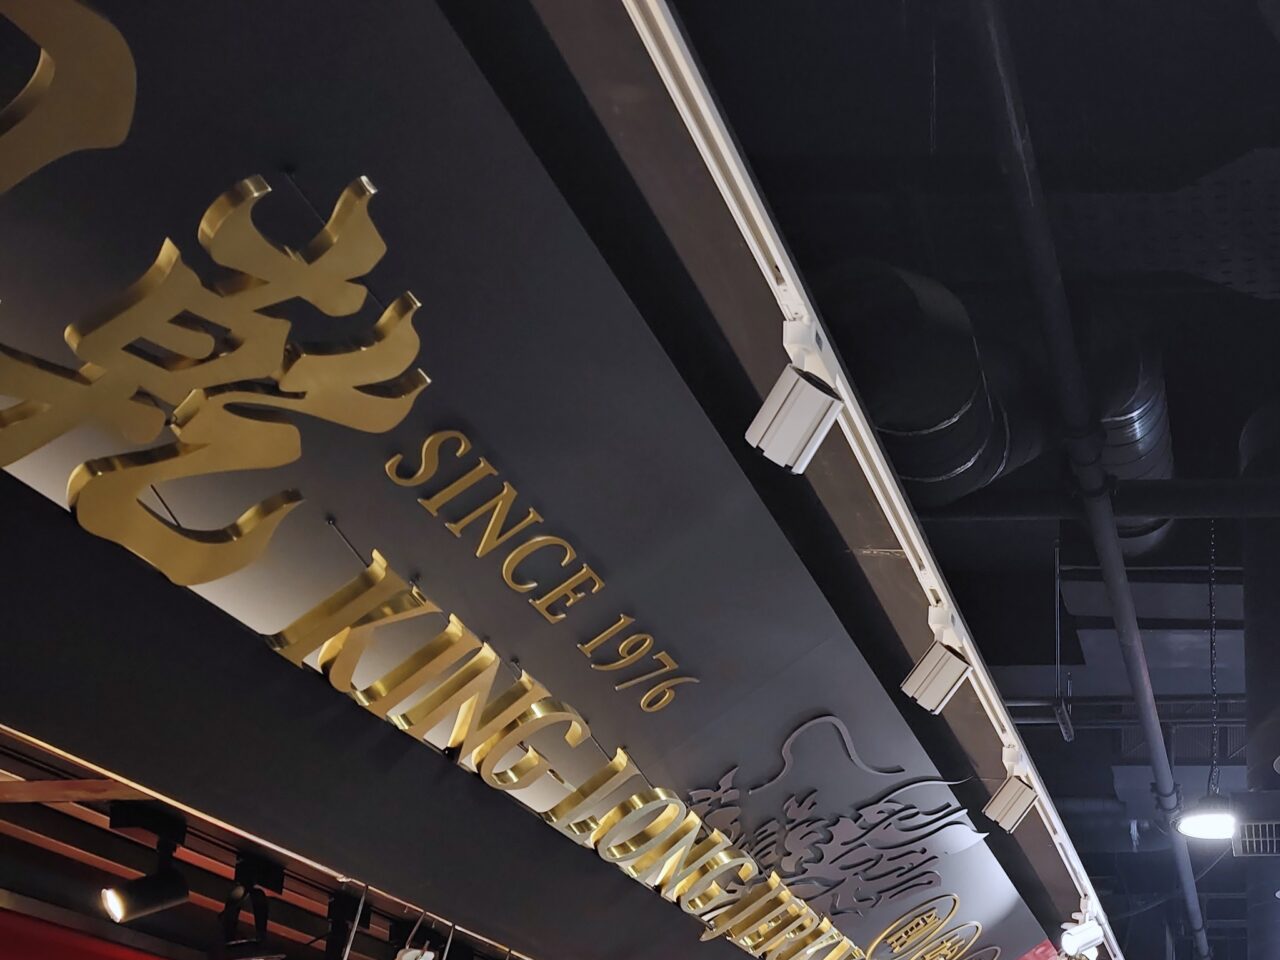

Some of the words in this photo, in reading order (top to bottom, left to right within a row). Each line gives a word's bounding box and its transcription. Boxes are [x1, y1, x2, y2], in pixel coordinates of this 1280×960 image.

[276, 548, 592, 790] KING
[545, 747, 758, 914] LONG
[384, 429, 605, 625] SINCE
[577, 613, 700, 714] 1976
